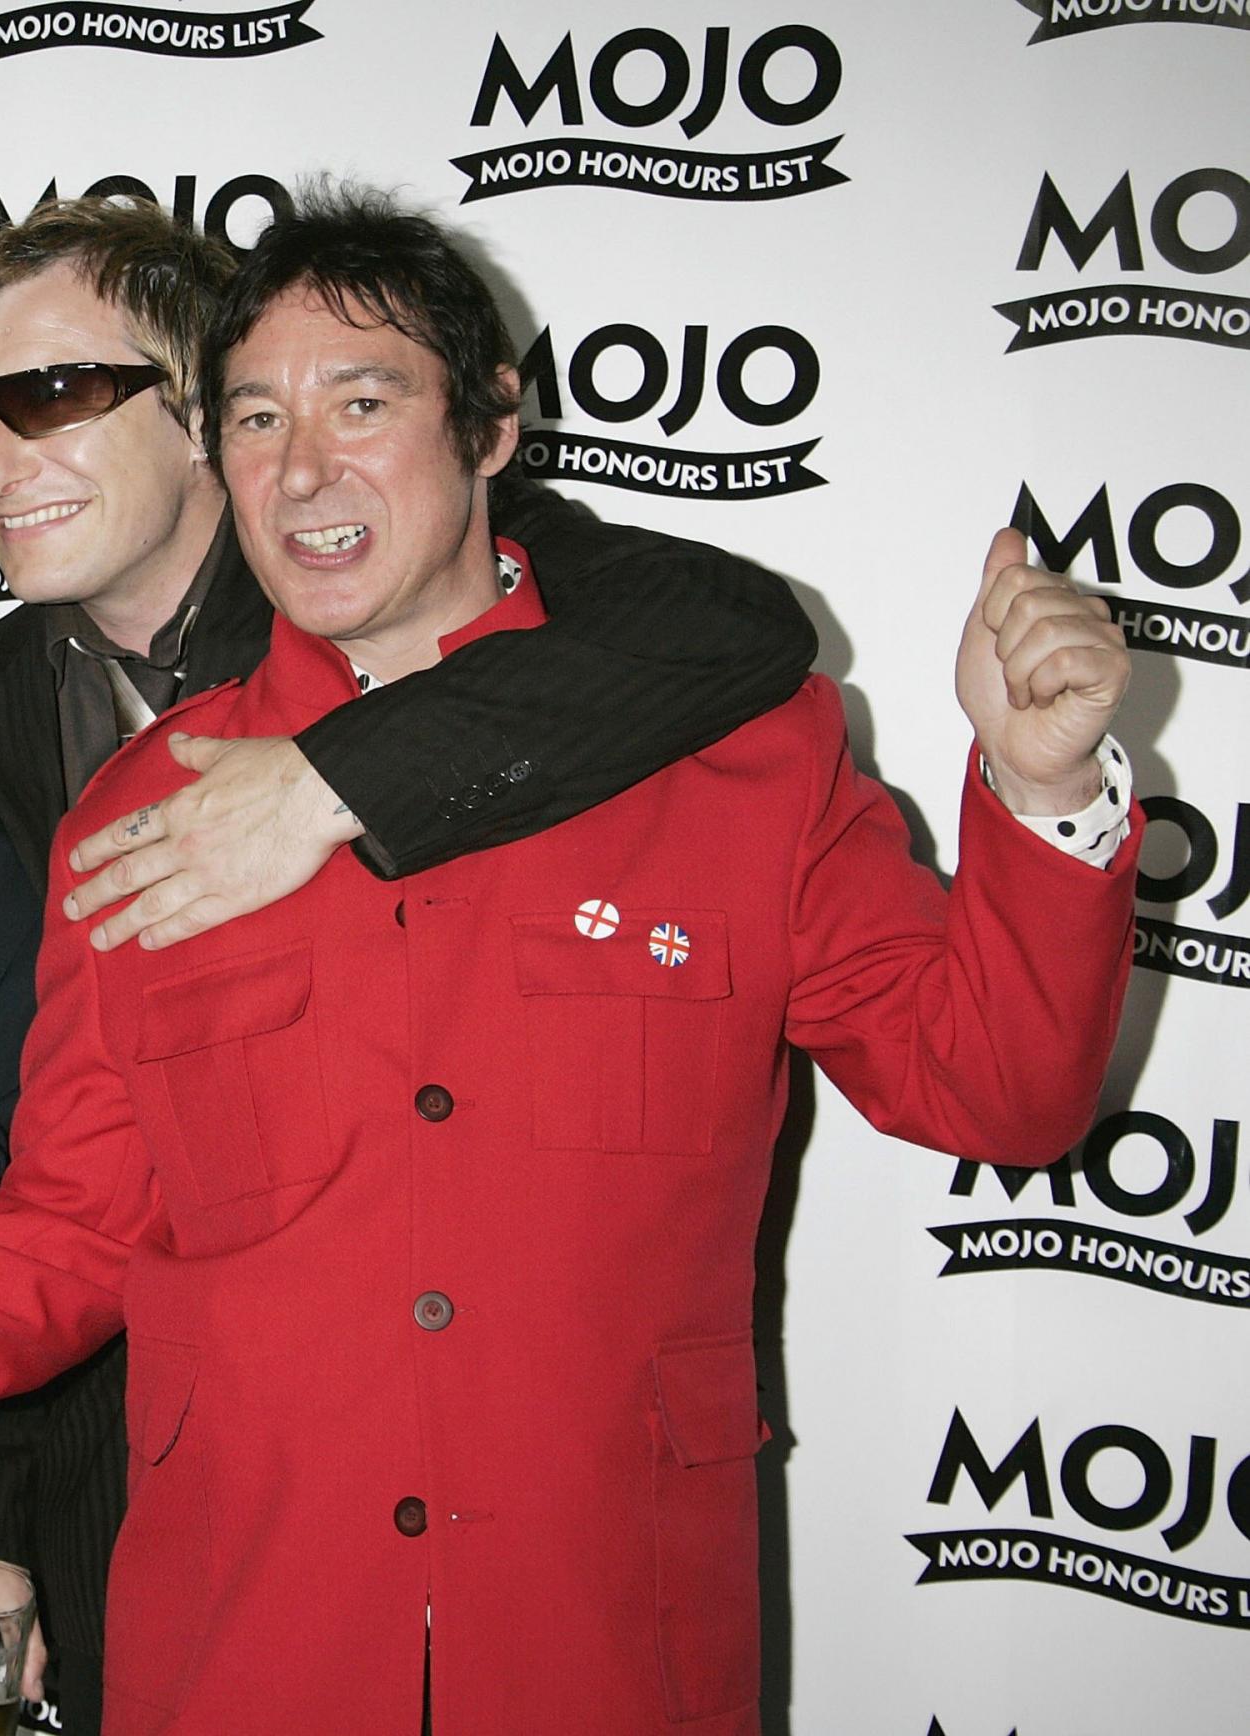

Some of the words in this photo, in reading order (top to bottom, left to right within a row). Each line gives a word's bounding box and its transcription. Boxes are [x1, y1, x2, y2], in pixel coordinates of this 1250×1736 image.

[83, 13, 224, 49] HONOURS
[234, 14, 290, 46] LIST
[470, 25, 842, 140] MOJO
[481, 150, 571, 184] MOJO
[579, 151, 739, 192] HONOURS
[749, 156, 812, 189] LIST
[1015, 167, 1250, 275] MO
[1028, 297, 1129, 332] MOJO
[1138, 298, 1250, 336] HONO
[558, 445, 717, 490] HONOURS
[728, 457, 791, 489] LIST
[1009, 478, 1250, 605] MO
[1119, 611, 1250, 658] HONOU
[1136, 796, 1250, 921] OJ
[1134, 929, 1250, 979] ONOUR
[949, 1110, 1250, 1237] OJ
[961, 1230, 1062, 1258] MOJO
[1070, 1231, 1250, 1298] HONOURS
[939, 1539, 1039, 1568] MOJO
[1049, 1547, 1228, 1615] HONOURS
